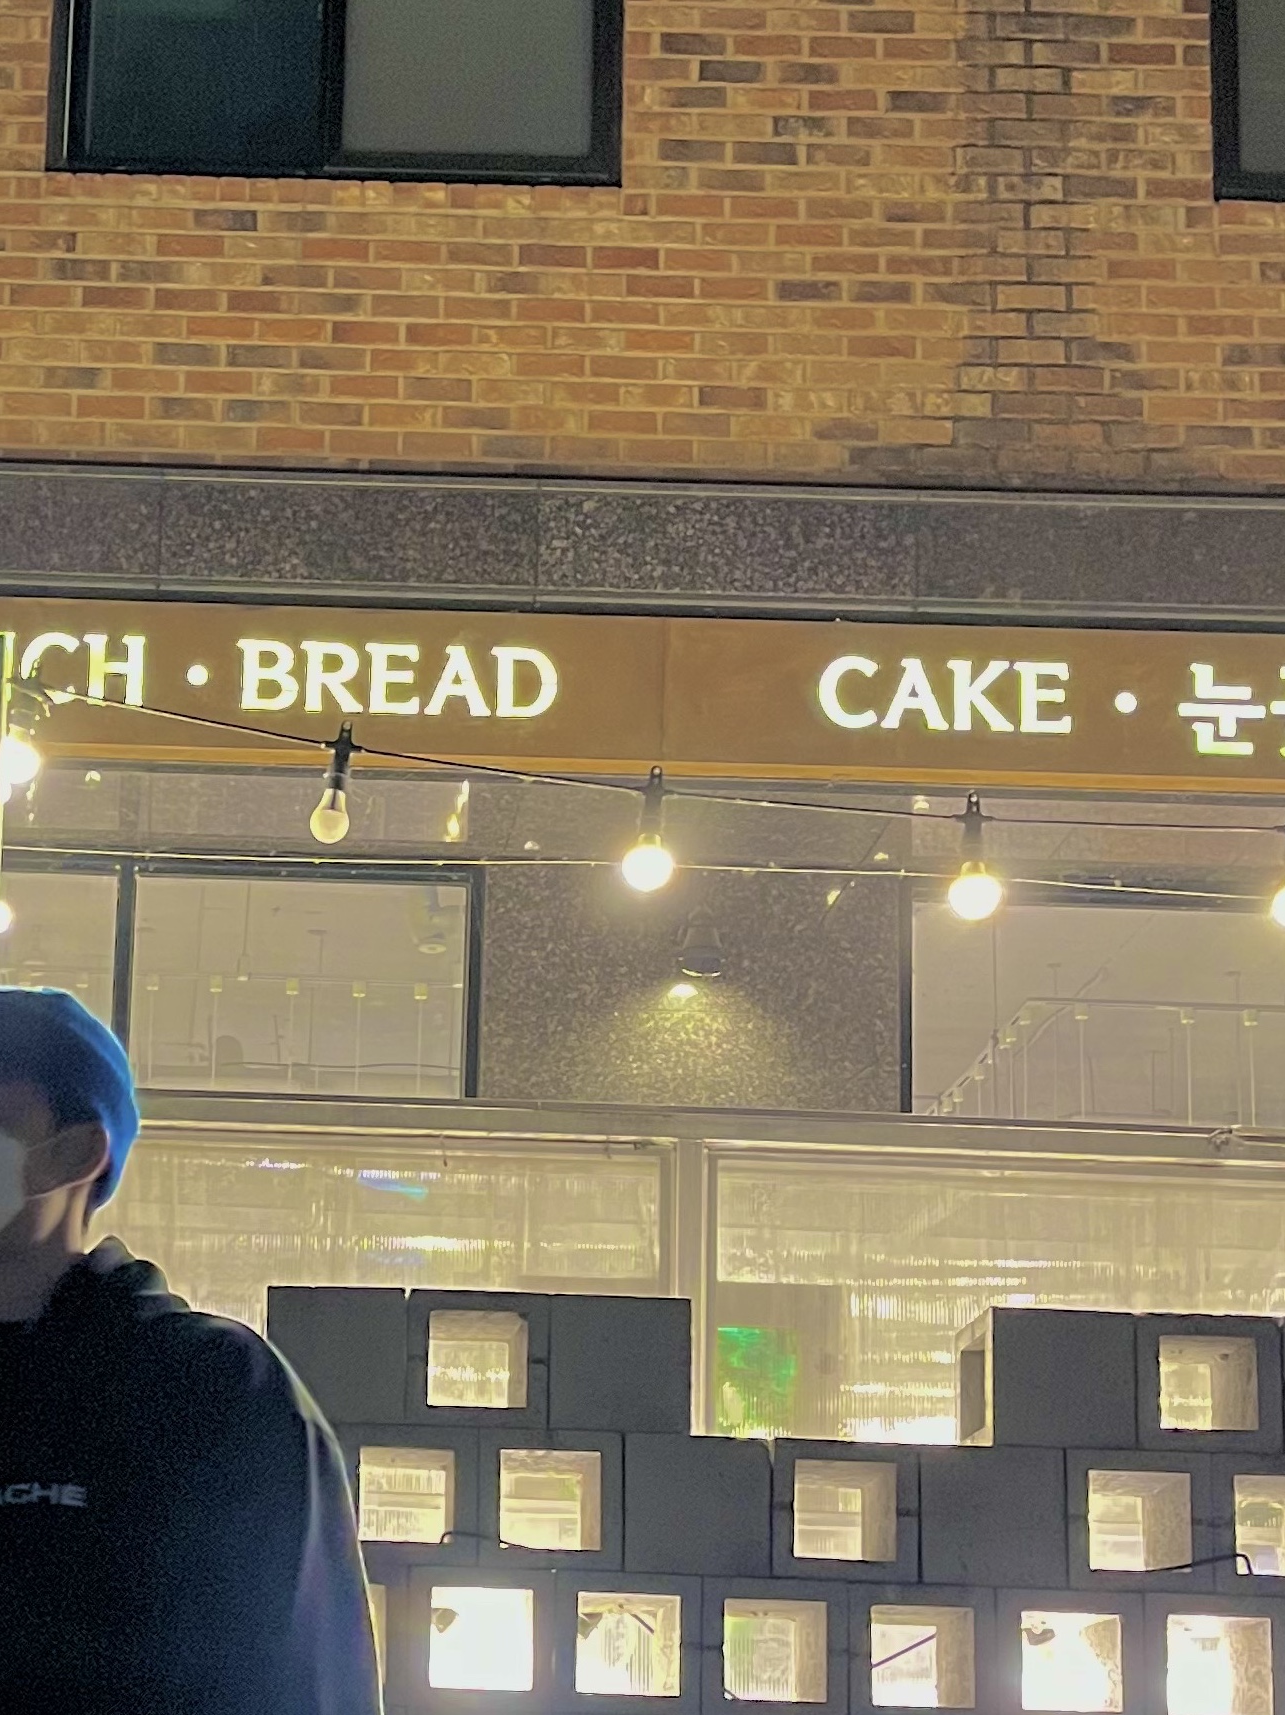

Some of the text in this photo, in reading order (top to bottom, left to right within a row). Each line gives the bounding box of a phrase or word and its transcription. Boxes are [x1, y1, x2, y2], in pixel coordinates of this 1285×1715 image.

[234, 637, 559, 719] BREAD
[817, 654, 1285, 758] CAKE 눈
